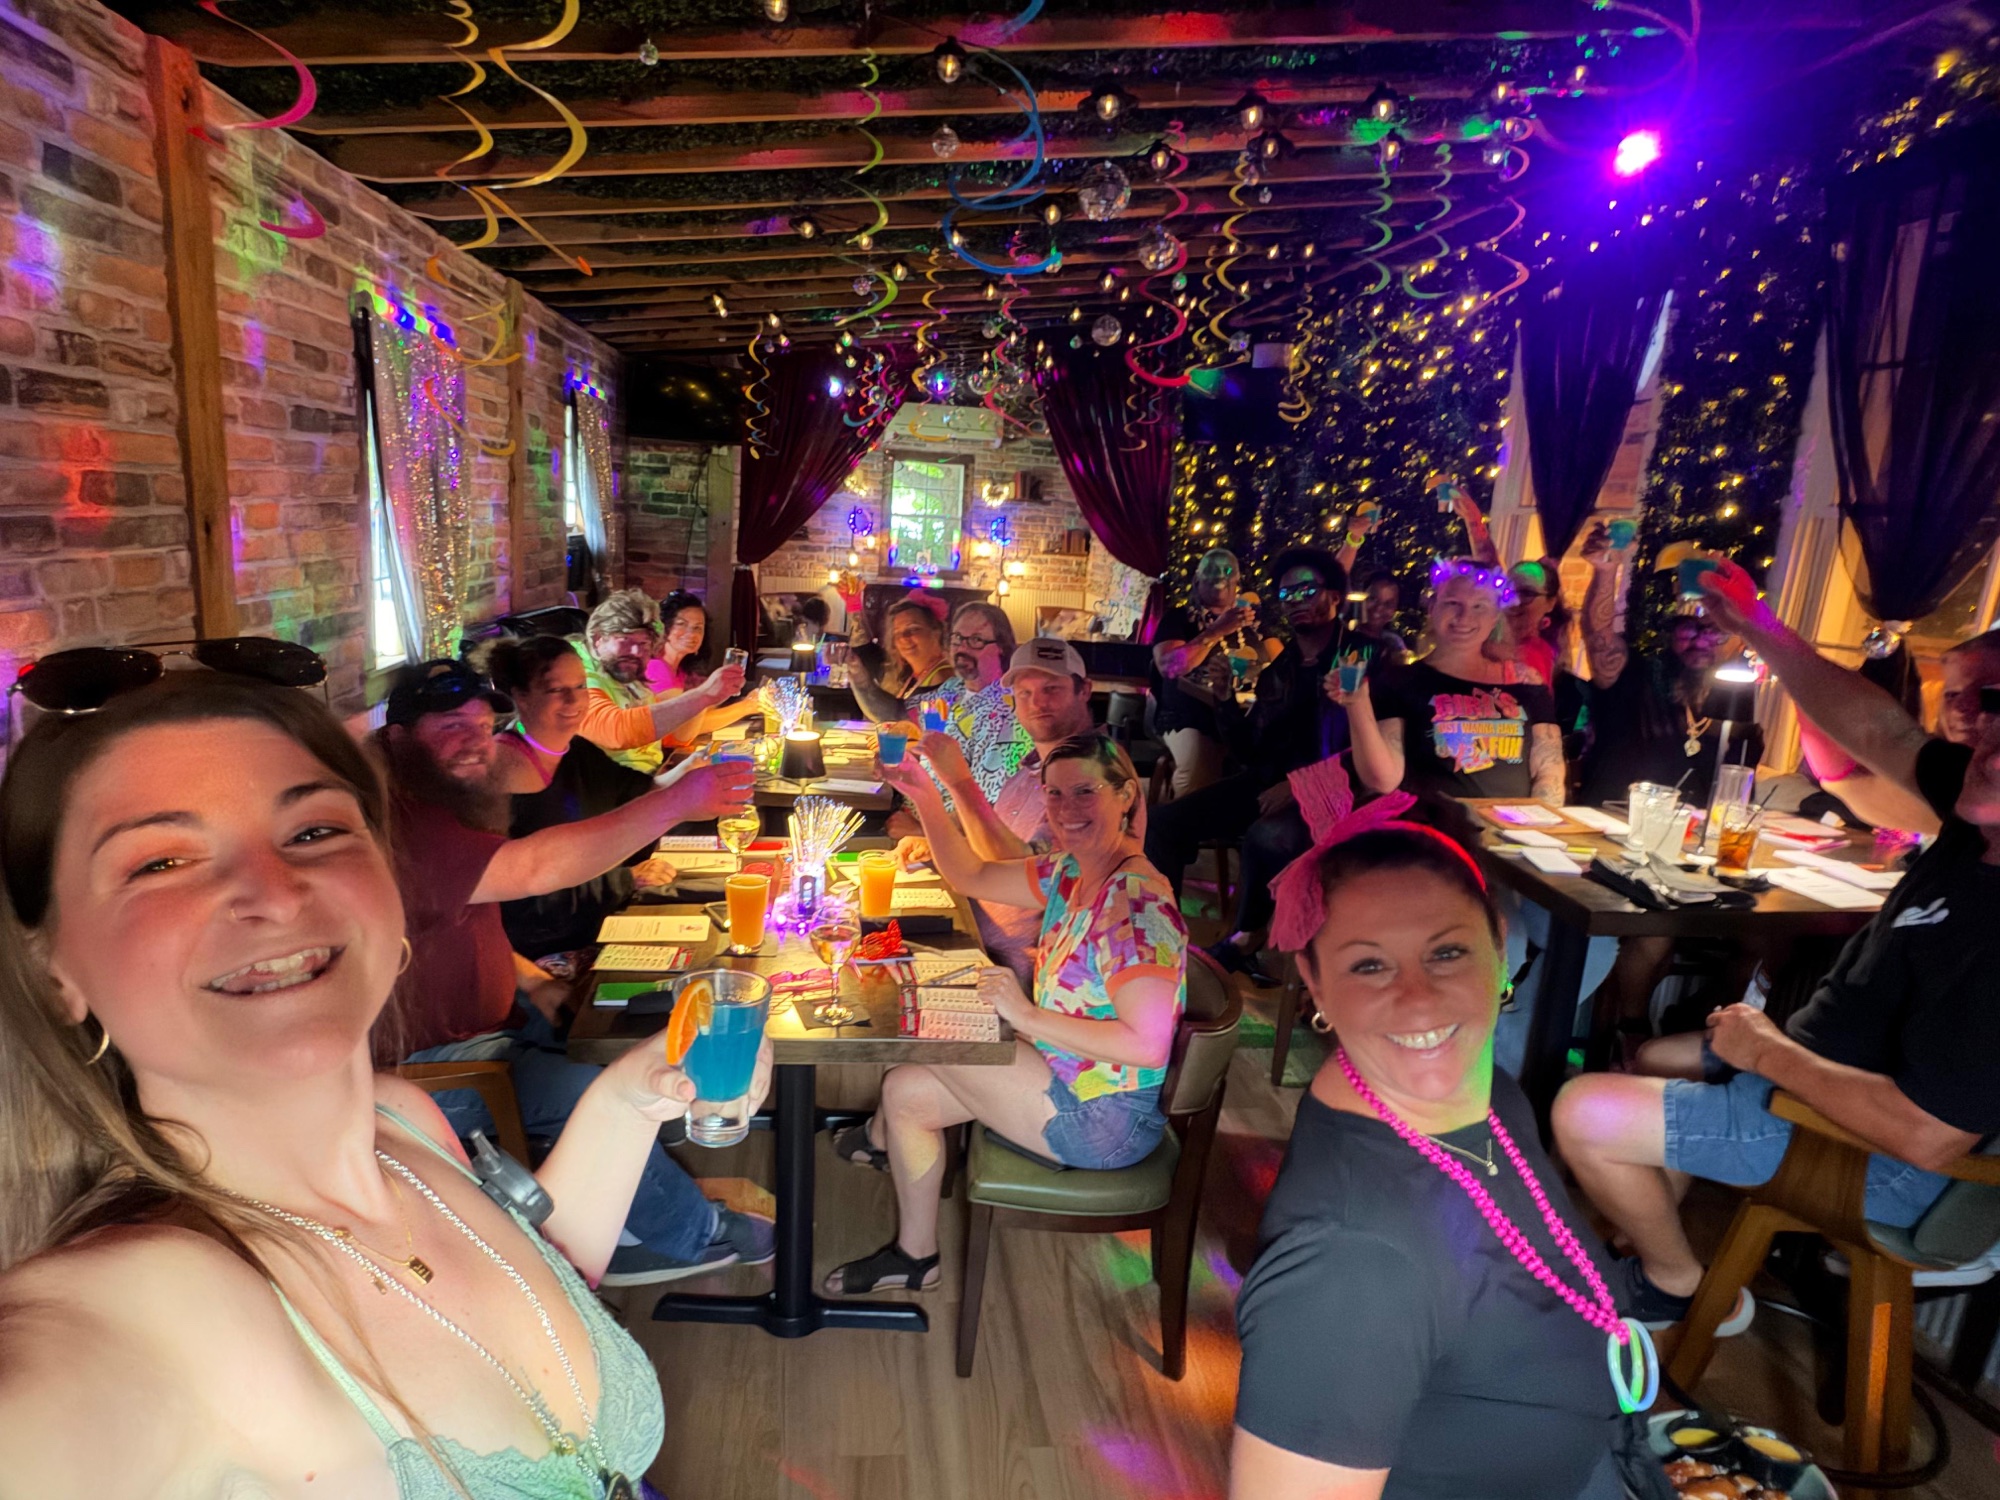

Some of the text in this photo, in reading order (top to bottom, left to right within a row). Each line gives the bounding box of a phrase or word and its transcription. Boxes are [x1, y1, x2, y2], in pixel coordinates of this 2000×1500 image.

[1461, 722, 1494, 734] WANNA
[1497, 722, 1519, 734] HAVE
[1488, 736, 1523, 760] FUN
